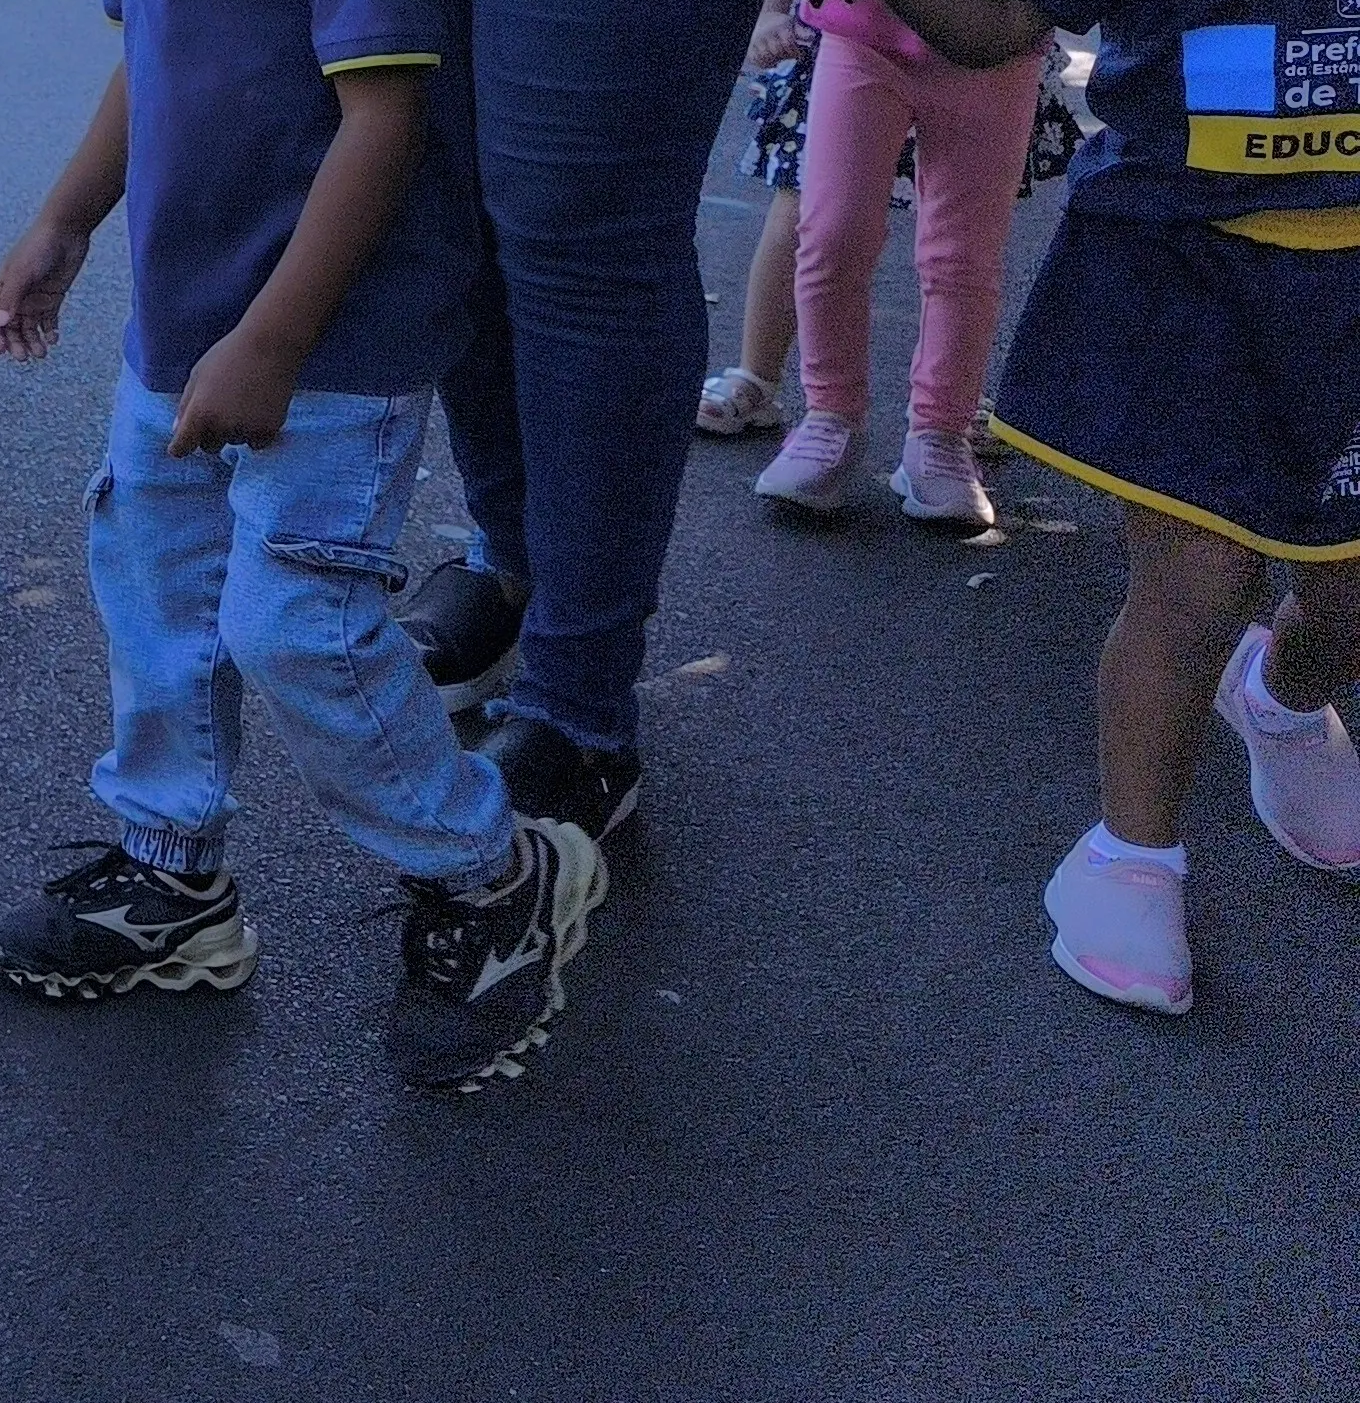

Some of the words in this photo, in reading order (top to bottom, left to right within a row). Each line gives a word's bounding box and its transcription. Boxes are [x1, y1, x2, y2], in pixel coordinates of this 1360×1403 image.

[1285, 36, 1360, 63] Pref
[1284, 65, 1307, 76] da
[1284, 79, 1336, 109] de
